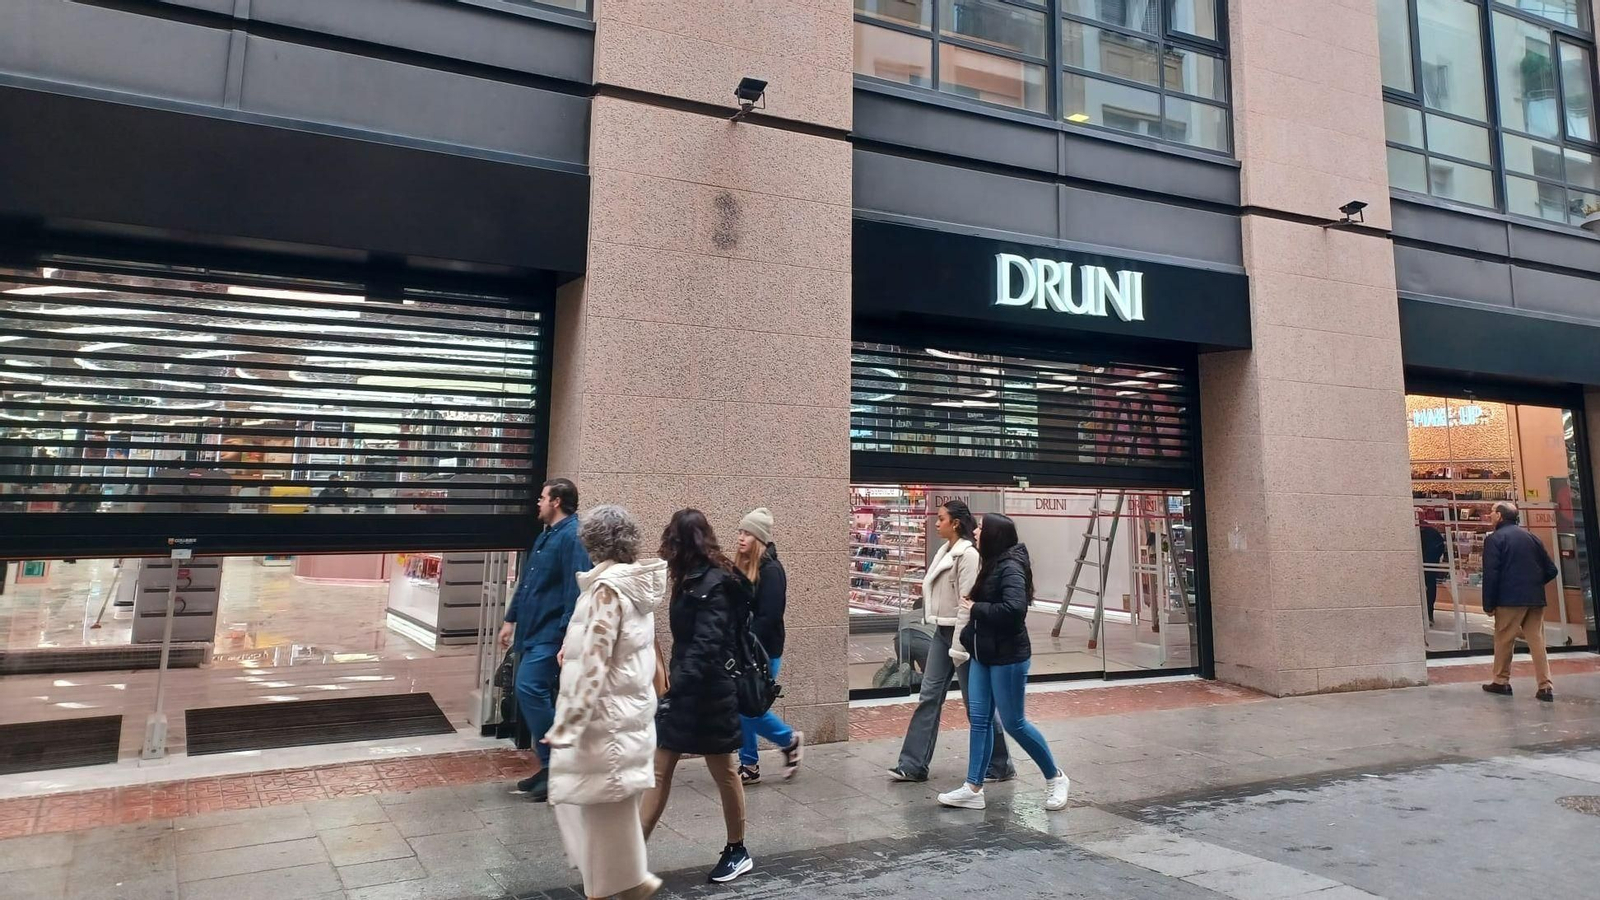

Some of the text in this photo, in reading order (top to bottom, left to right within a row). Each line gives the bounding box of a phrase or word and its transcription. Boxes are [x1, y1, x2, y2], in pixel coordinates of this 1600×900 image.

[995, 253, 1145, 322] DRUNI
[1459, 405, 1483, 425] UP
[1035, 497, 1067, 511] DRUNI
